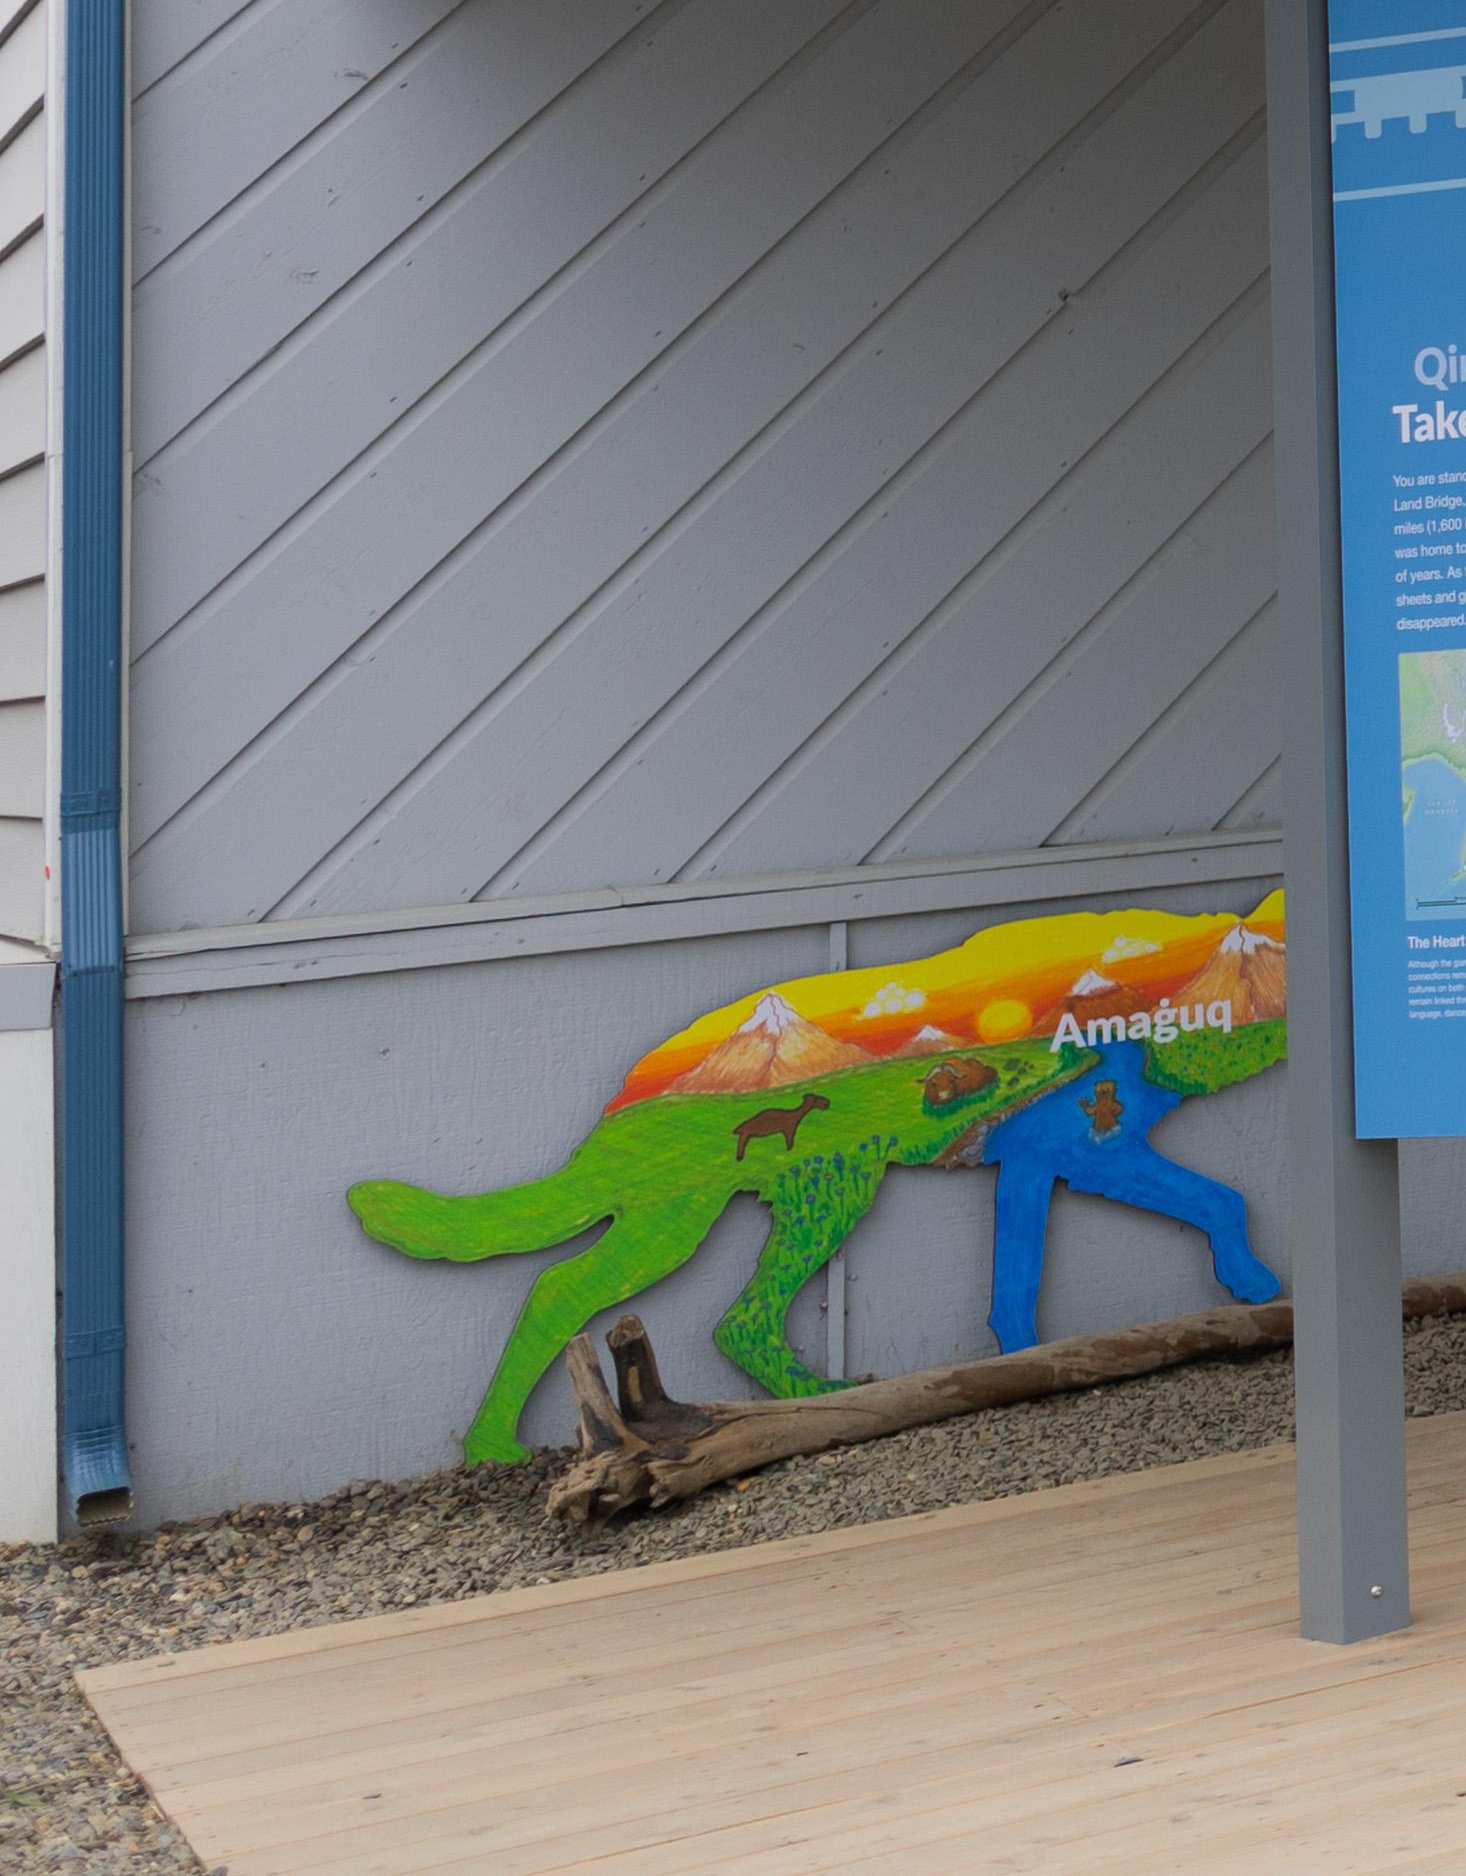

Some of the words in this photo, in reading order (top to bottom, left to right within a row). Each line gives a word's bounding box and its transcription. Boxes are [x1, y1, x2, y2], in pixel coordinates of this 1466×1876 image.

[1393, 475, 1414, 486] You
[1417, 475, 1435, 485] are
[1394, 497, 1422, 511] Land
[1425, 495, 1465, 509] Bridge,
[1394, 522, 1424, 534] miles
[1427, 517, 1462, 534] (1,600
[1395, 547, 1418, 558] was
[1420, 545, 1453, 556] home
[1456, 542, 1466, 553] to
[1395, 569, 1406, 582] of
[1410, 569, 1443, 583] years.
[1447, 565, 1462, 578] As
[1396, 593, 1432, 606] sheets
[1434, 590, 1456, 603] and
[1397, 613, 1466, 629] disappeared.
[1408, 936, 1429, 948] The
[1433, 935, 1464, 947] Heart
[1050, 997, 1232, 1053] Amaġuq
